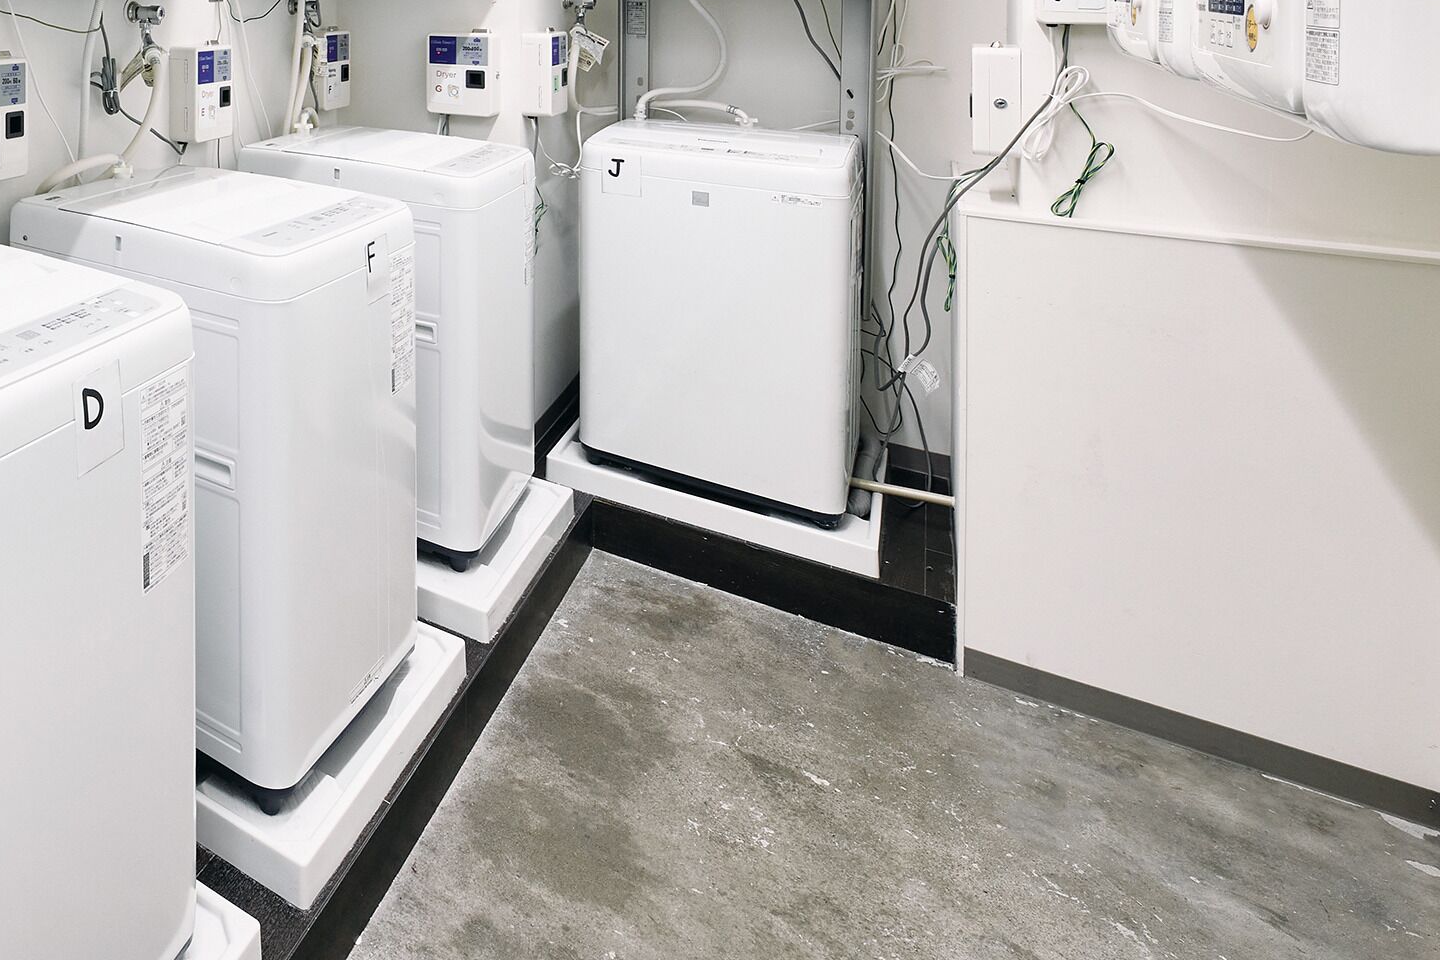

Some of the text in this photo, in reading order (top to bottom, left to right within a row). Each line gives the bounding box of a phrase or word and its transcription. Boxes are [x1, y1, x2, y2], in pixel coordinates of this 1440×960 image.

[436, 70, 457, 80] Dryer
[435, 84, 443, 93] G
[608, 158, 625, 178] J
[366, 240, 376, 274] F
[81, 387, 105, 431] D
